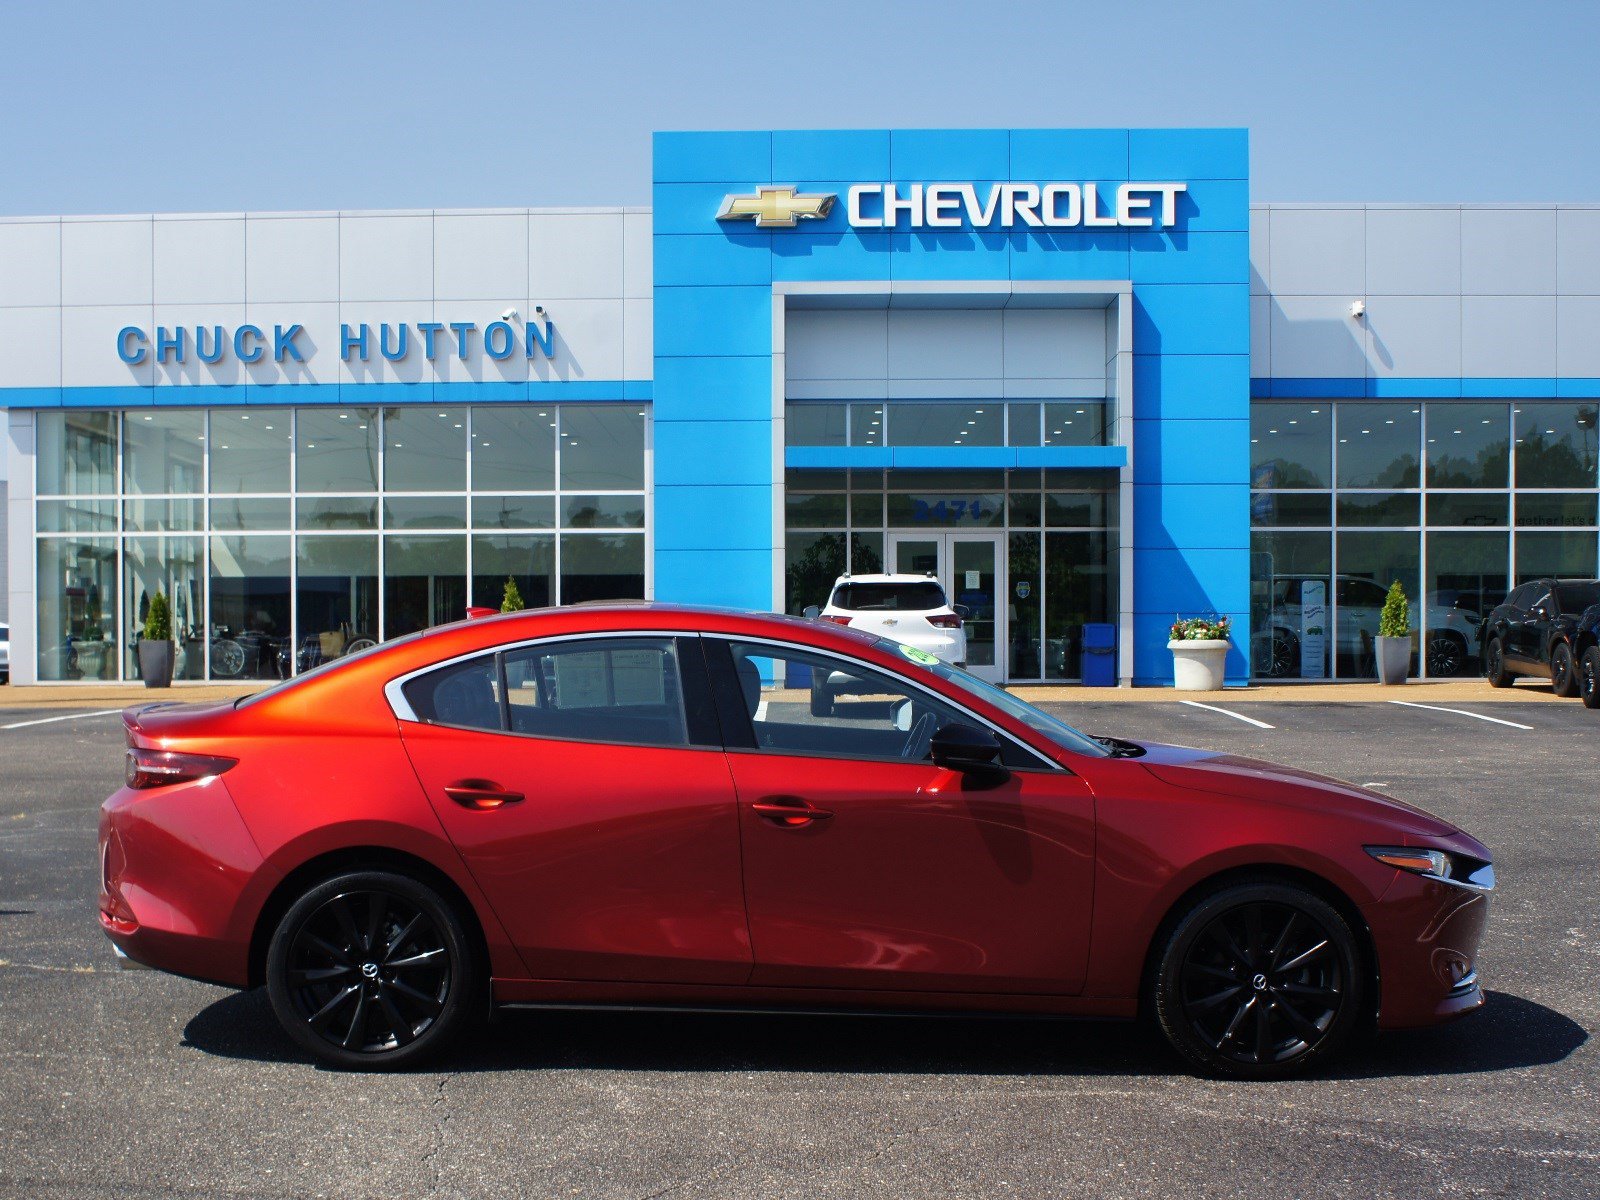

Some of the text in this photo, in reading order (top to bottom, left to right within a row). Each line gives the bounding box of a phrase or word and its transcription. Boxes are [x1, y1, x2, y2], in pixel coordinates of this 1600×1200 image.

[847, 183, 1187, 228] CHEVROLET
[117, 321, 555, 365] CHUCK HUTTON
[912, 499, 981, 522] 2471
